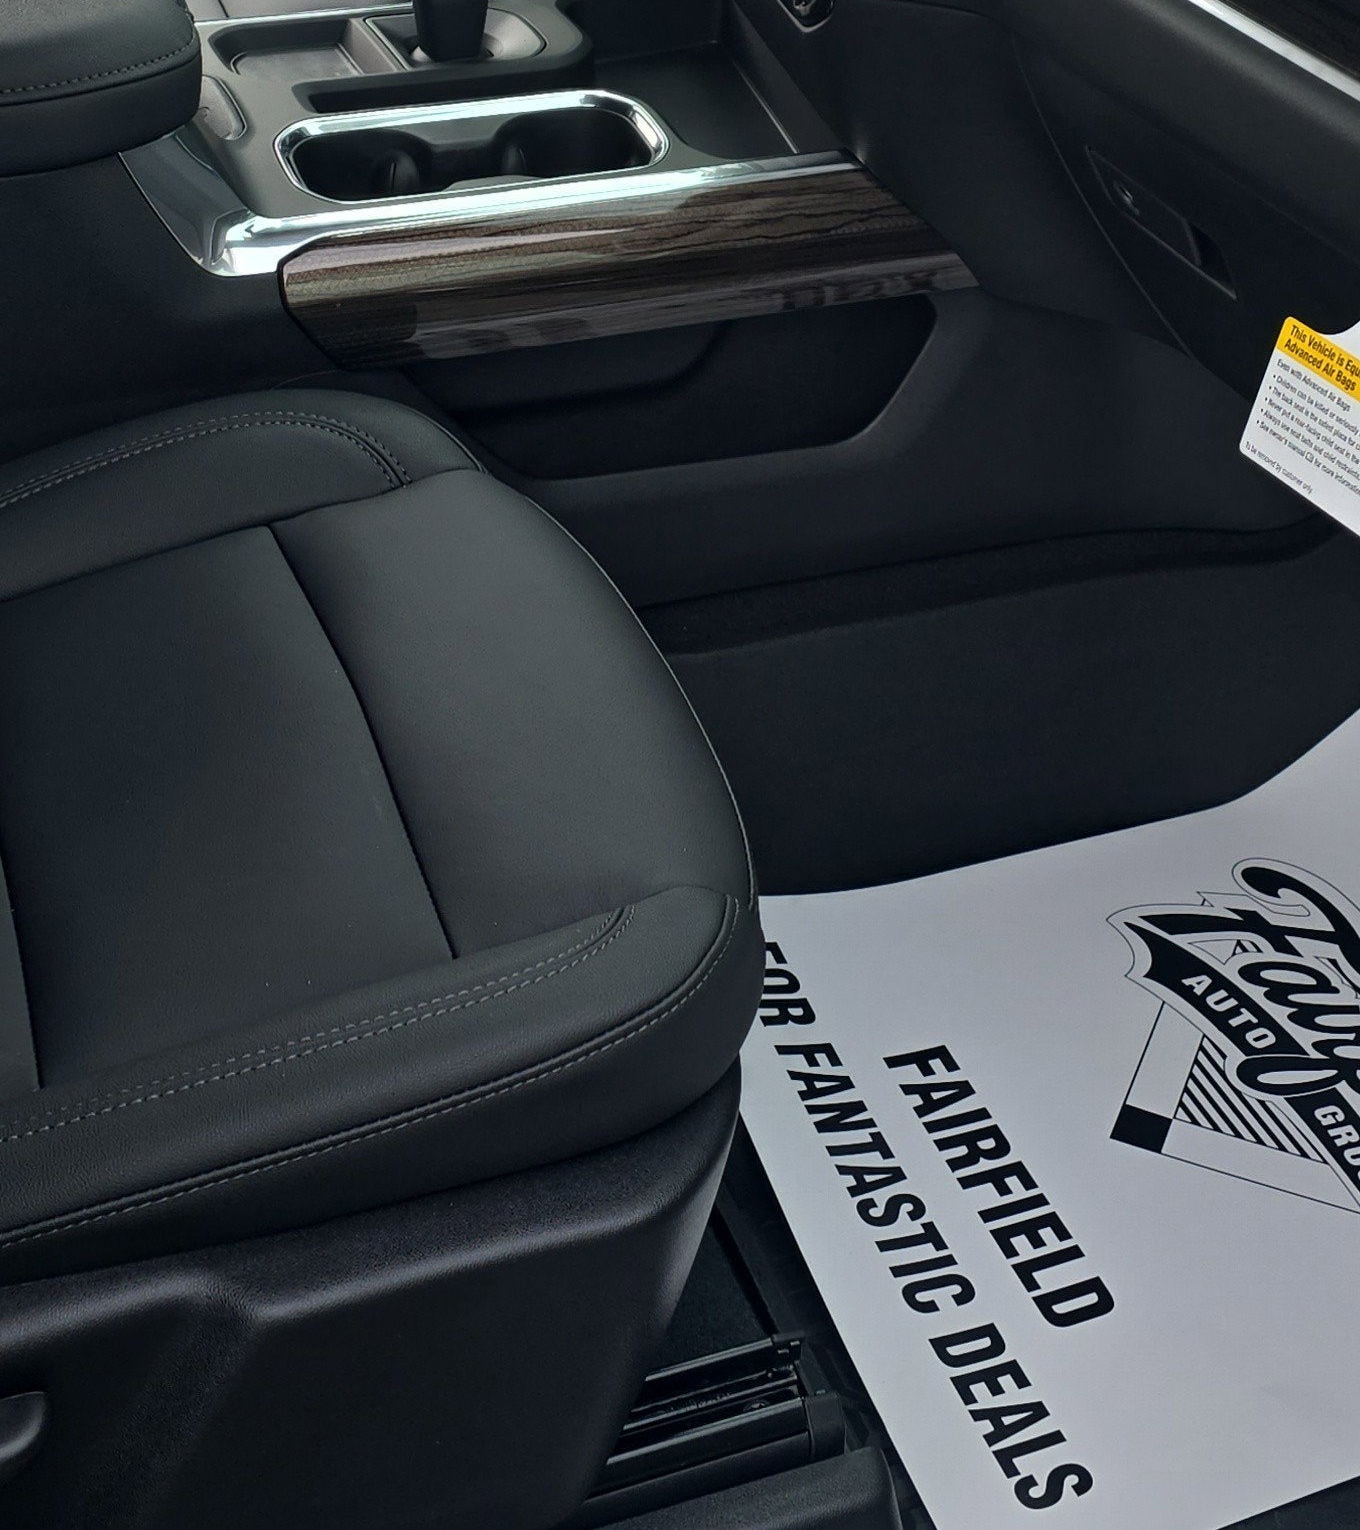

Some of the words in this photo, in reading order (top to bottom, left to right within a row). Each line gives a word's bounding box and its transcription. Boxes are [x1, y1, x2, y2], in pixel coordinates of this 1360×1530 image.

[1284, 338, 1323, 369] Advanced
[1322, 362, 1335, 377] Air
[1335, 370, 1356, 391] Bags
[1290, 324, 1306, 342] This
[1307, 335, 1336, 360] Vehicle
[1335, 353, 1344, 366] is
[1181, 971, 1277, 1050] AUTO
[883, 1044, 1115, 1328] FAIRFIELD
[774, 1042, 976, 1314] FANTASTIC
[928, 1322, 1093, 1510] DEALS
